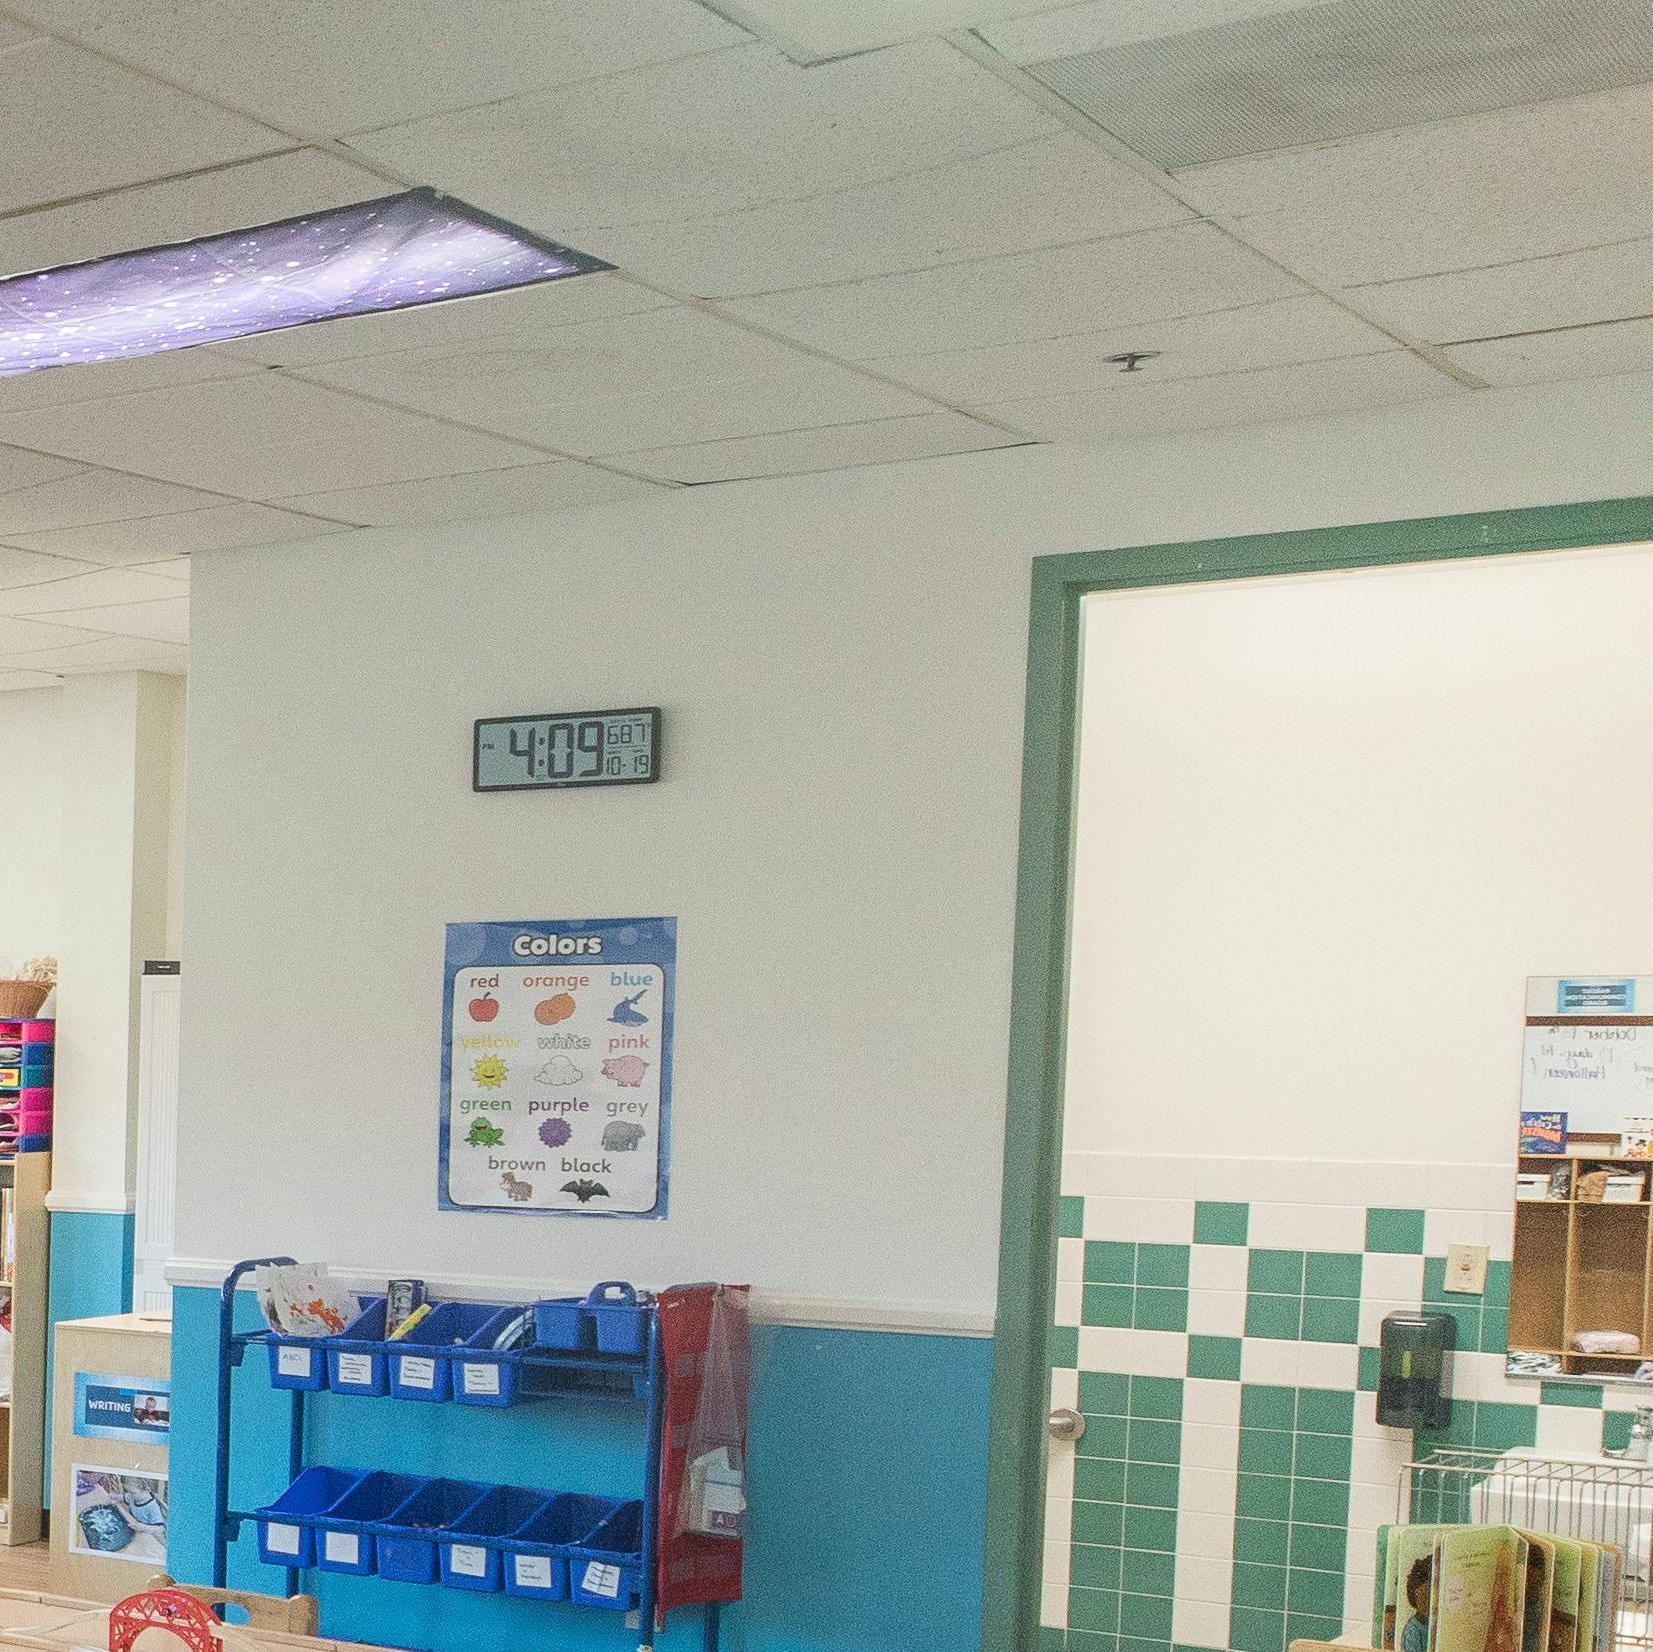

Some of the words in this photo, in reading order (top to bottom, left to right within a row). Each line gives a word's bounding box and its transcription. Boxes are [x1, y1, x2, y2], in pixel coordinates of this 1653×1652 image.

[509, 720, 605, 779] 4:09
[512, 934, 603, 957] Colors
[469, 973, 500, 989] red
[522, 975, 590, 994] orange
[610, 971, 654, 987] blue
[459, 1035, 521, 1051] yellow
[536, 1033, 592, 1050] white
[607, 1033, 651, 1054] pink
[459, 1099, 512, 1115] green
[528, 1097, 590, 1115] purple
[606, 1101, 649, 1118] grey
[488, 1155, 546, 1172] brown
[560, 1157, 612, 1174] black
[88, 1399, 132, 1413] WRITING
